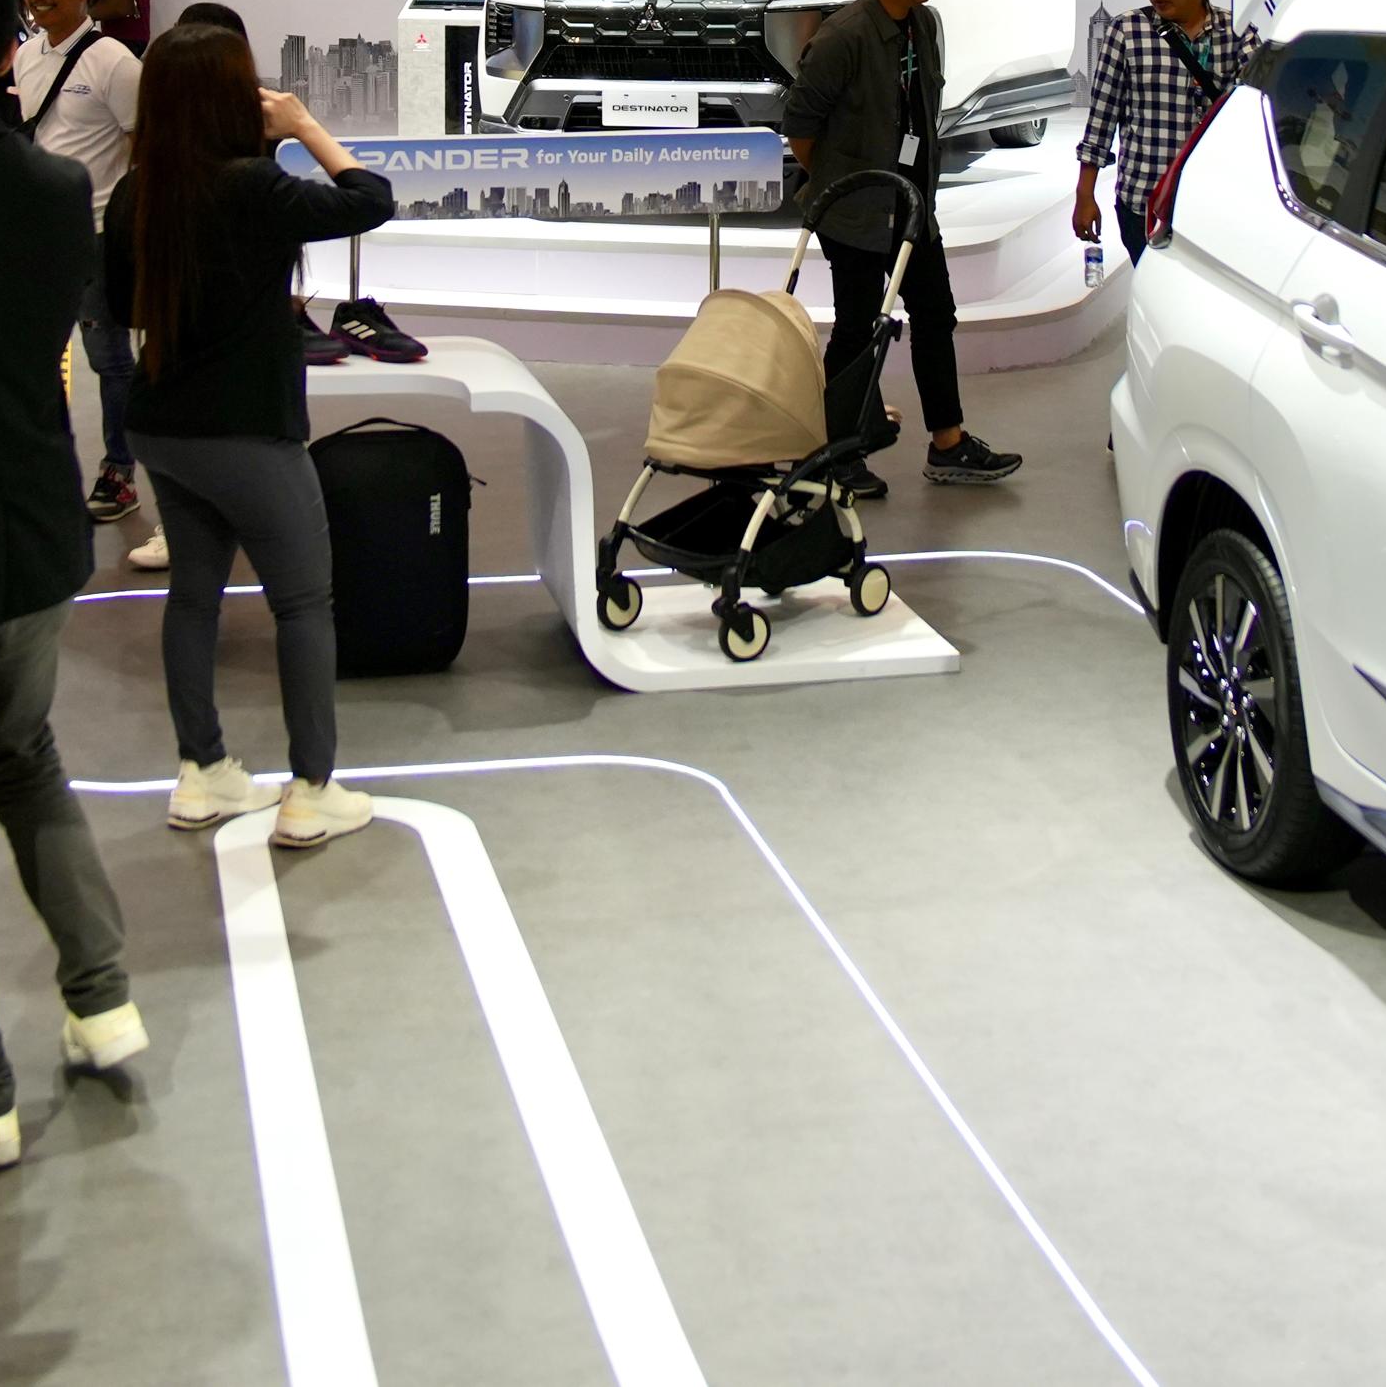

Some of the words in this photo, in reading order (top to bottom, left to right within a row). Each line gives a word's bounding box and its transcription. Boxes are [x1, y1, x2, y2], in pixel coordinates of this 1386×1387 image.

[463, 61, 473, 135] STINATOR
[612, 104, 689, 113] DESTINATOR
[535, 148, 564, 164] for
[567, 149, 607, 164] Your
[611, 147, 655, 165] Daily
[658, 146, 751, 162] Adventure
[429, 492, 441, 535] THULE
